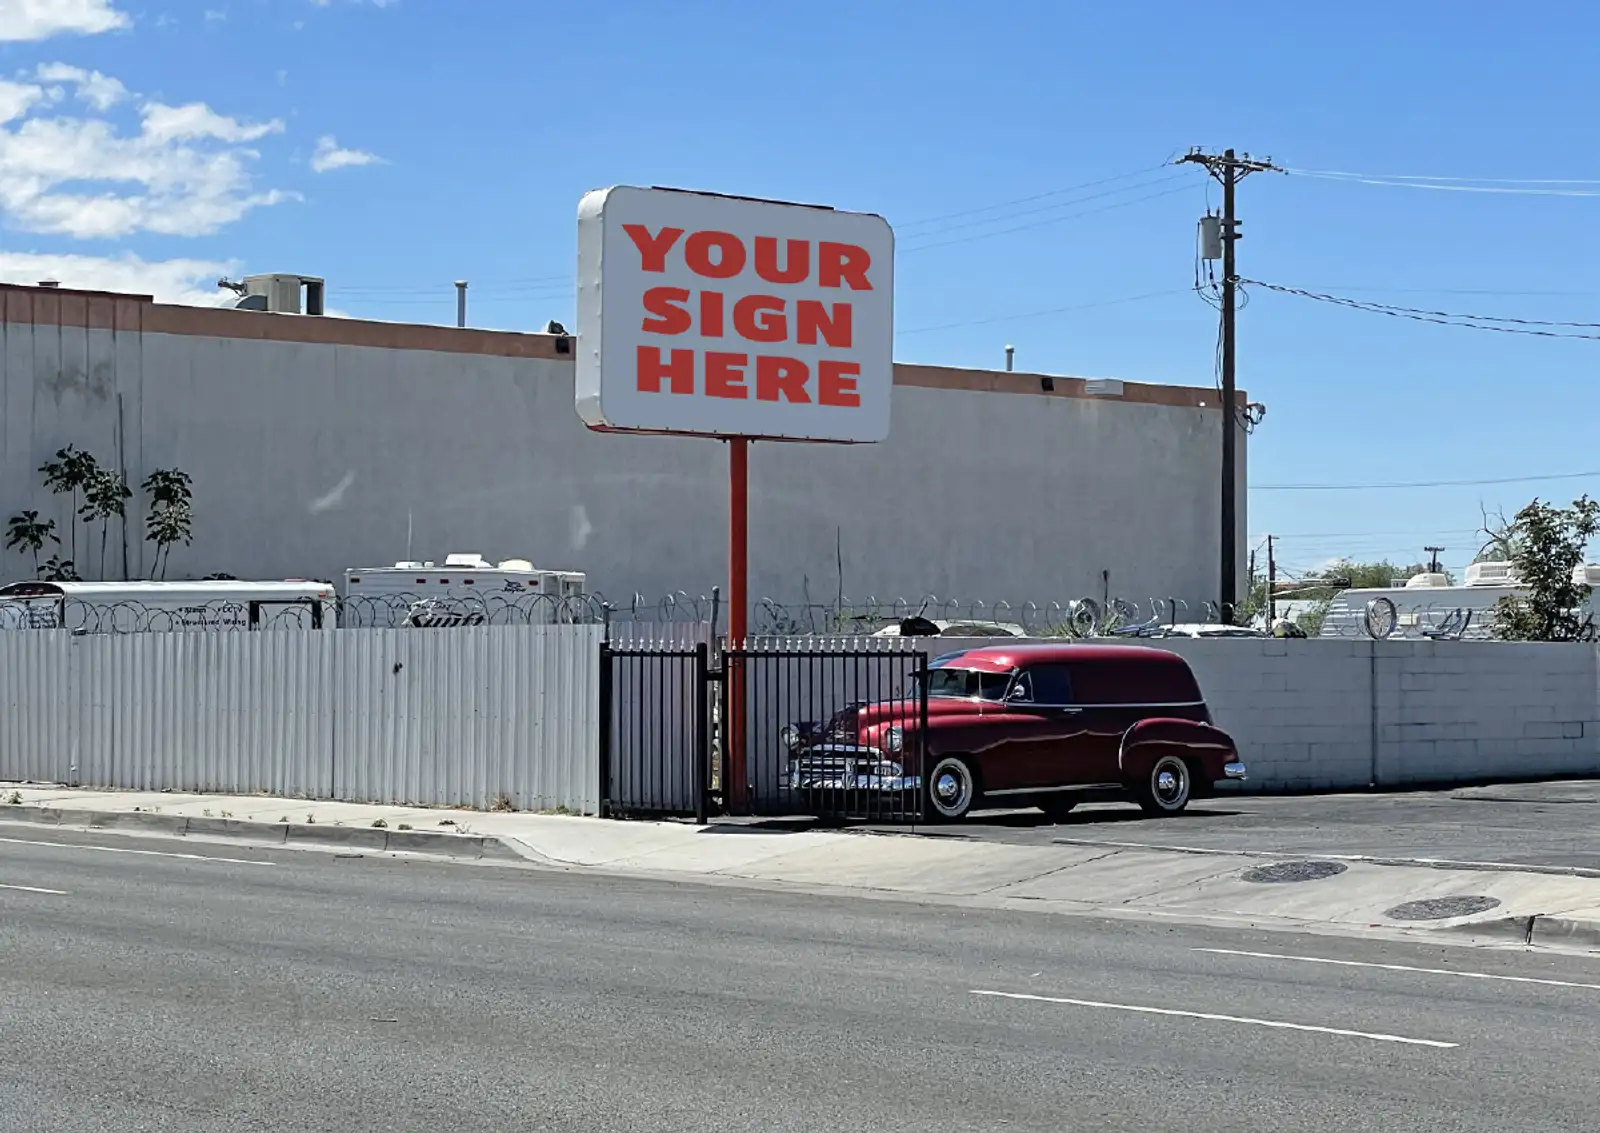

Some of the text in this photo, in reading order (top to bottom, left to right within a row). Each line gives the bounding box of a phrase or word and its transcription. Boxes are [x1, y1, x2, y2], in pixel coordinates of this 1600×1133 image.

[621, 223, 874, 291] YOUR
[641, 286, 853, 349] SIGN
[636, 345, 862, 408] HERE
